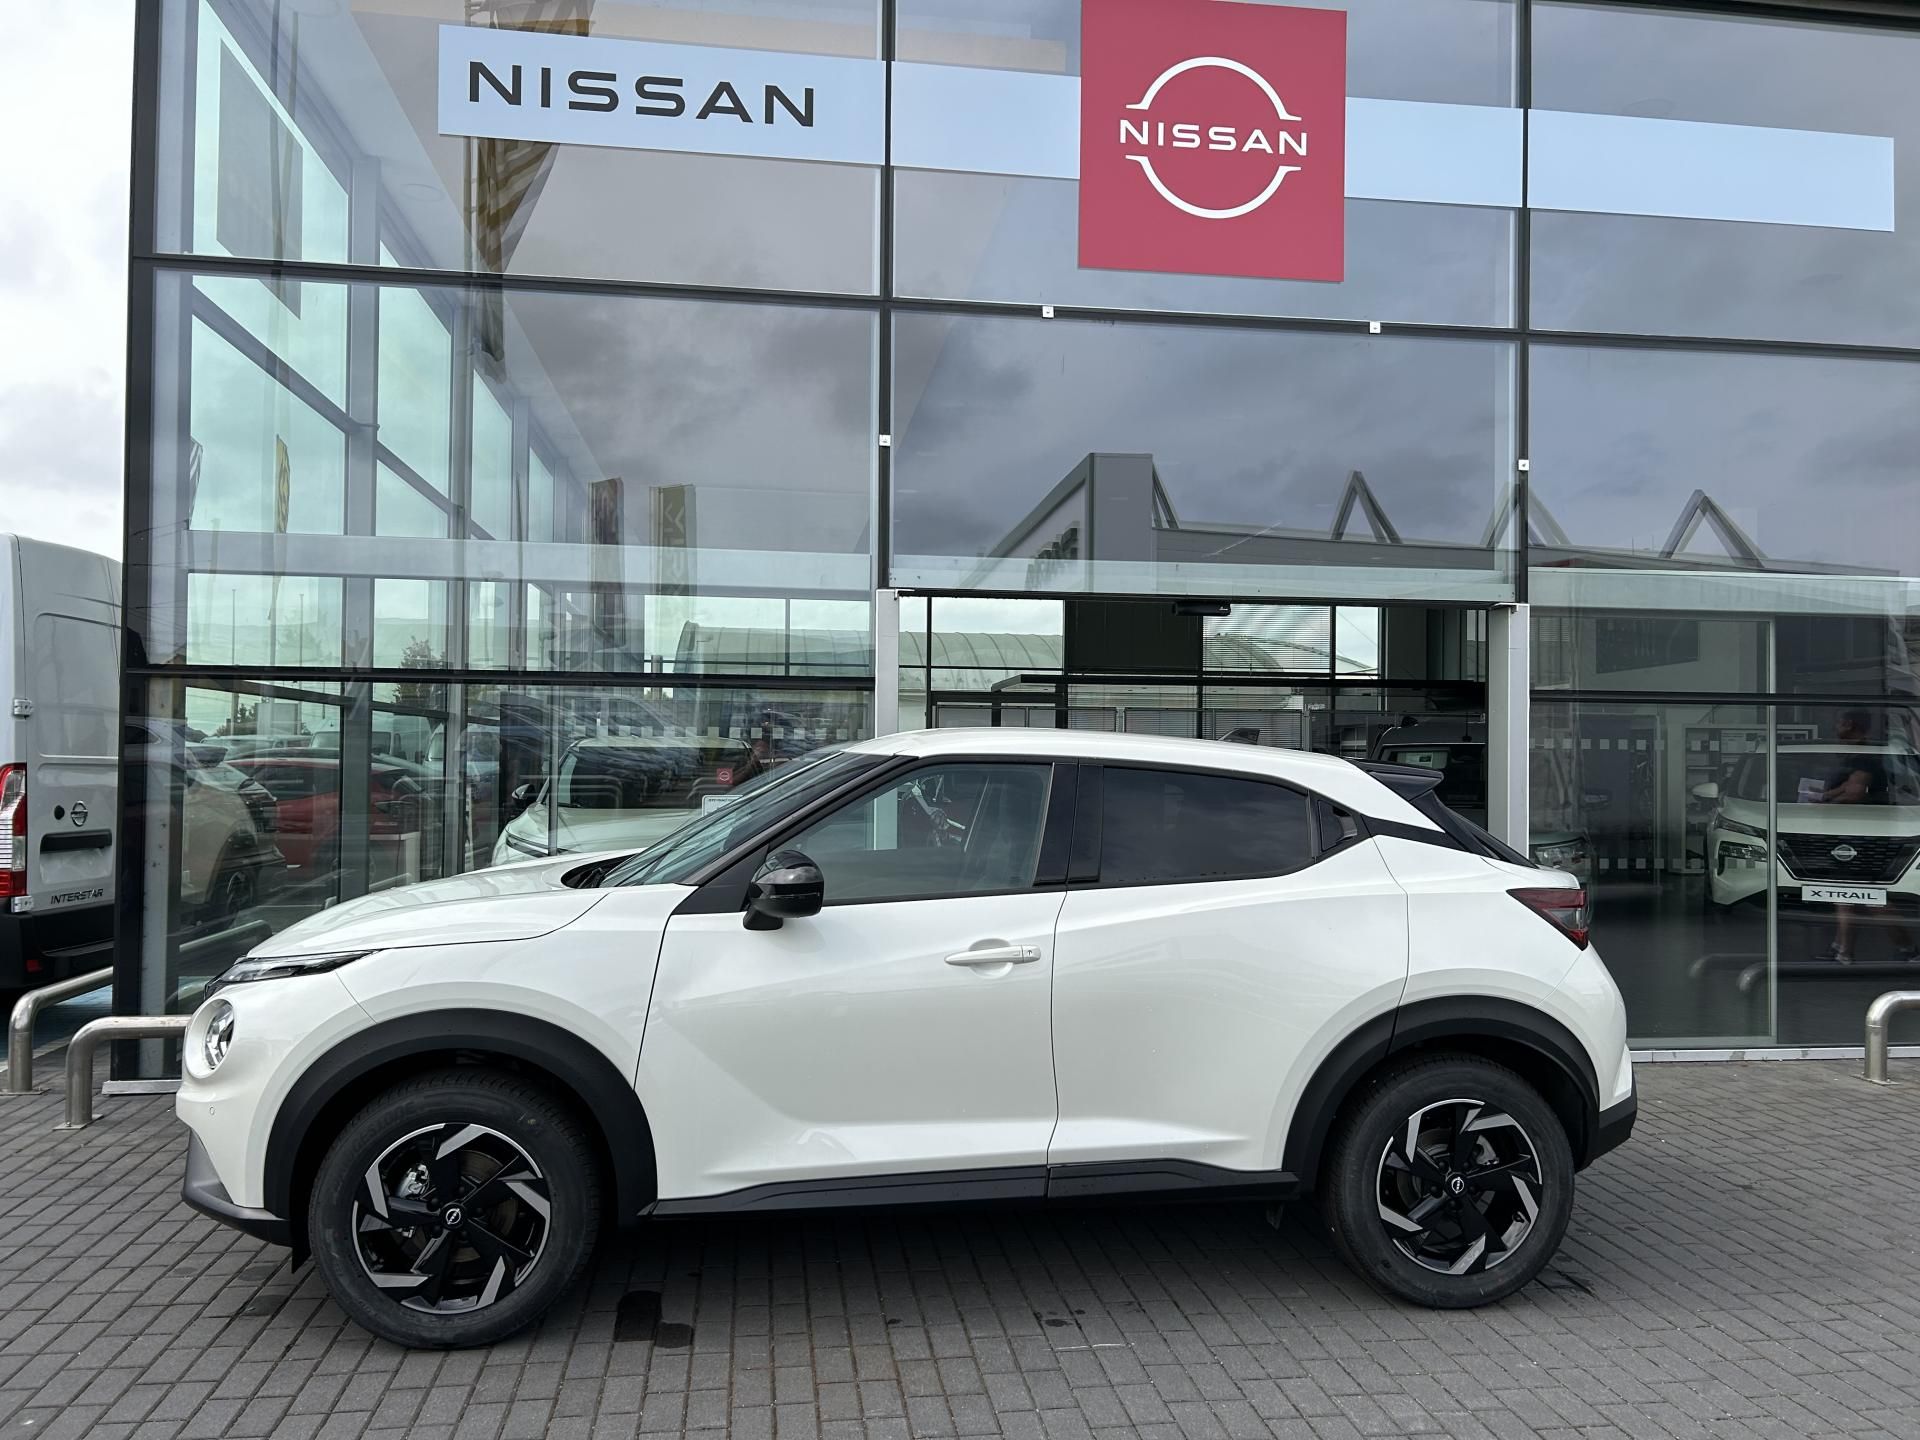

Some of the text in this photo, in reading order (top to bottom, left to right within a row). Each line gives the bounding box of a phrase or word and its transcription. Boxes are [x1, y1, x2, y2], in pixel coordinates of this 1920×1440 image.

[469, 60, 814, 127] NISSAN
[1119, 119, 1308, 156] NISSAN
[50, 888, 104, 904] INTERSTAR
[1810, 890, 1878, 900] X TRAIL
